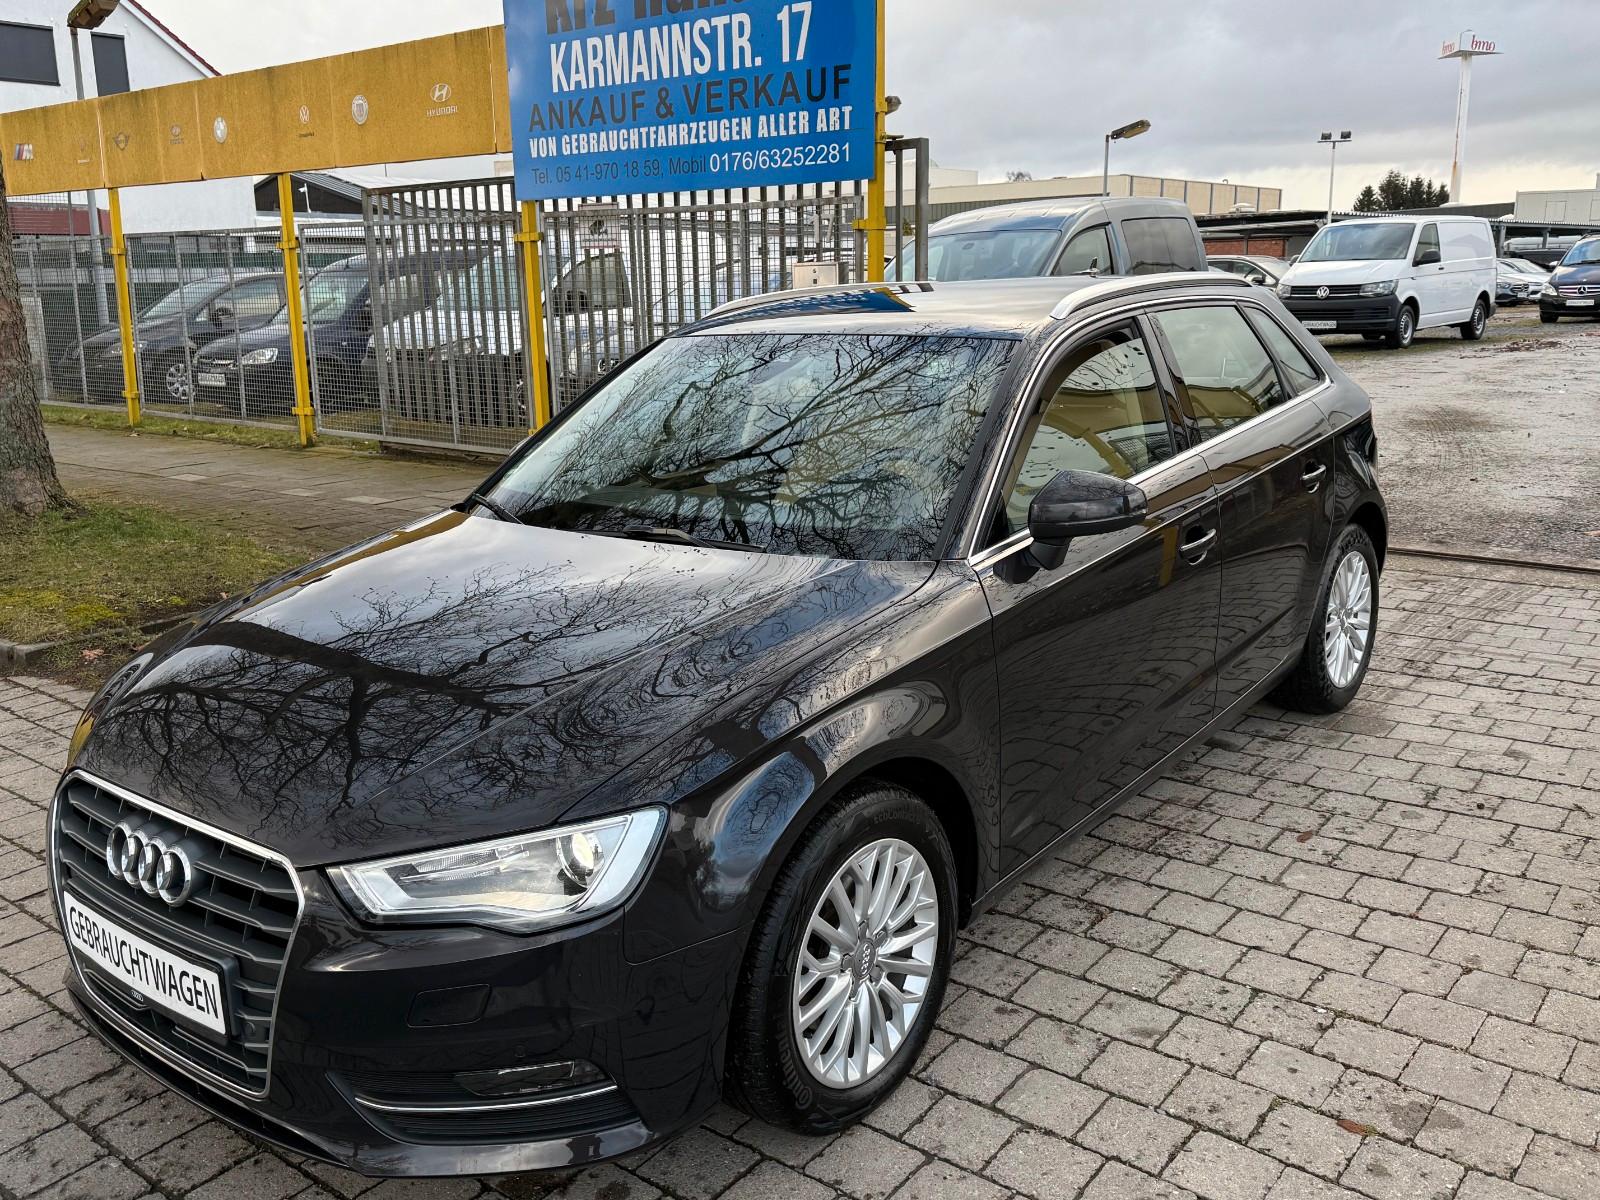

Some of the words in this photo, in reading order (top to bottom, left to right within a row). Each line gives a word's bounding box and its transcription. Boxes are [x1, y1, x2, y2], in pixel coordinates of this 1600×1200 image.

[550, 12, 762, 93] KARMANNSTR.
[776, 1, 813, 63] 17
[528, 90, 646, 132] ANKAUF
[655, 86, 675, 119] &
[682, 64, 852, 116] VERKAUF
[529, 136, 557, 159] VON
[562, 116, 752, 156] GEBRAUCHTFAHRZEUGEN
[757, 110, 810, 138] ALLER
[816, 105, 853, 133] ART
[532, 168, 553, 184] Tel.
[556, 166, 571, 183] 05
[574, 162, 619, 182] 41-970
[624, 160, 640, 178] 18
[643, 159, 664, 179] 59,
[669, 154, 706, 176] Mobil
[709, 142, 850, 173] 0176/63252281
[69, 906, 219, 1019] GEBRAUCHTWAGEN
